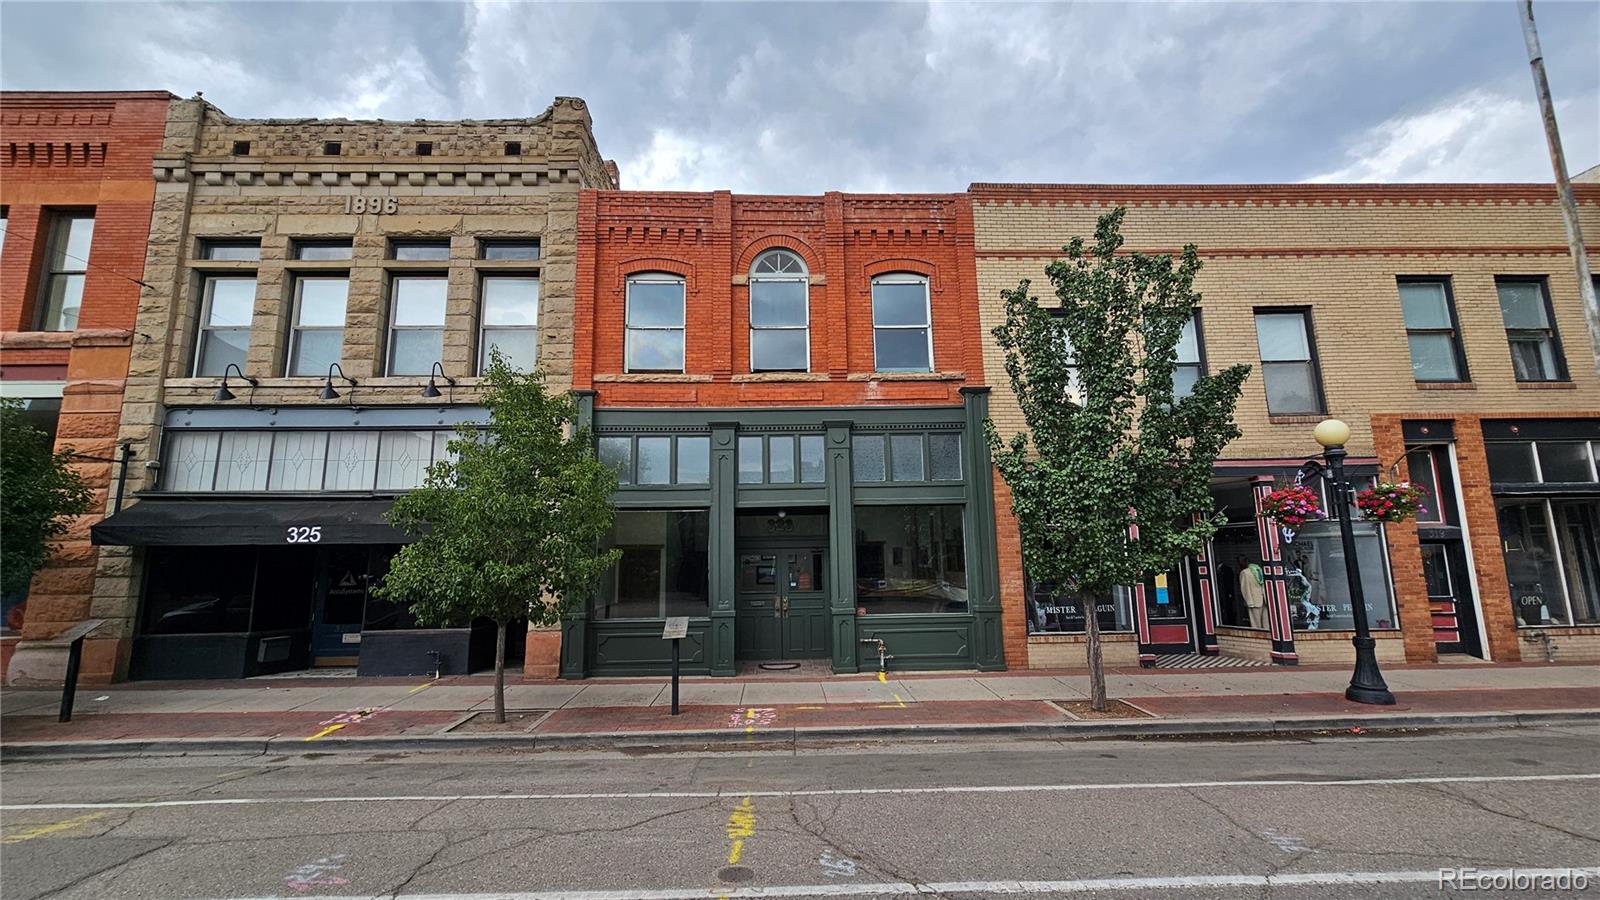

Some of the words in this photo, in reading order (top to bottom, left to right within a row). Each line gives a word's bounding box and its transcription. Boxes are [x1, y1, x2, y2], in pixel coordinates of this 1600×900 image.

[345, 196, 398, 215] 1896
[287, 527, 321, 542] 325
[1521, 595, 1542, 606] OPEN
[1046, 605, 1076, 614] MISTER
[1096, 604, 1115, 613] GUIN
[1316, 604, 1337, 612] STER
[1343, 603, 1373, 612] PEIN
